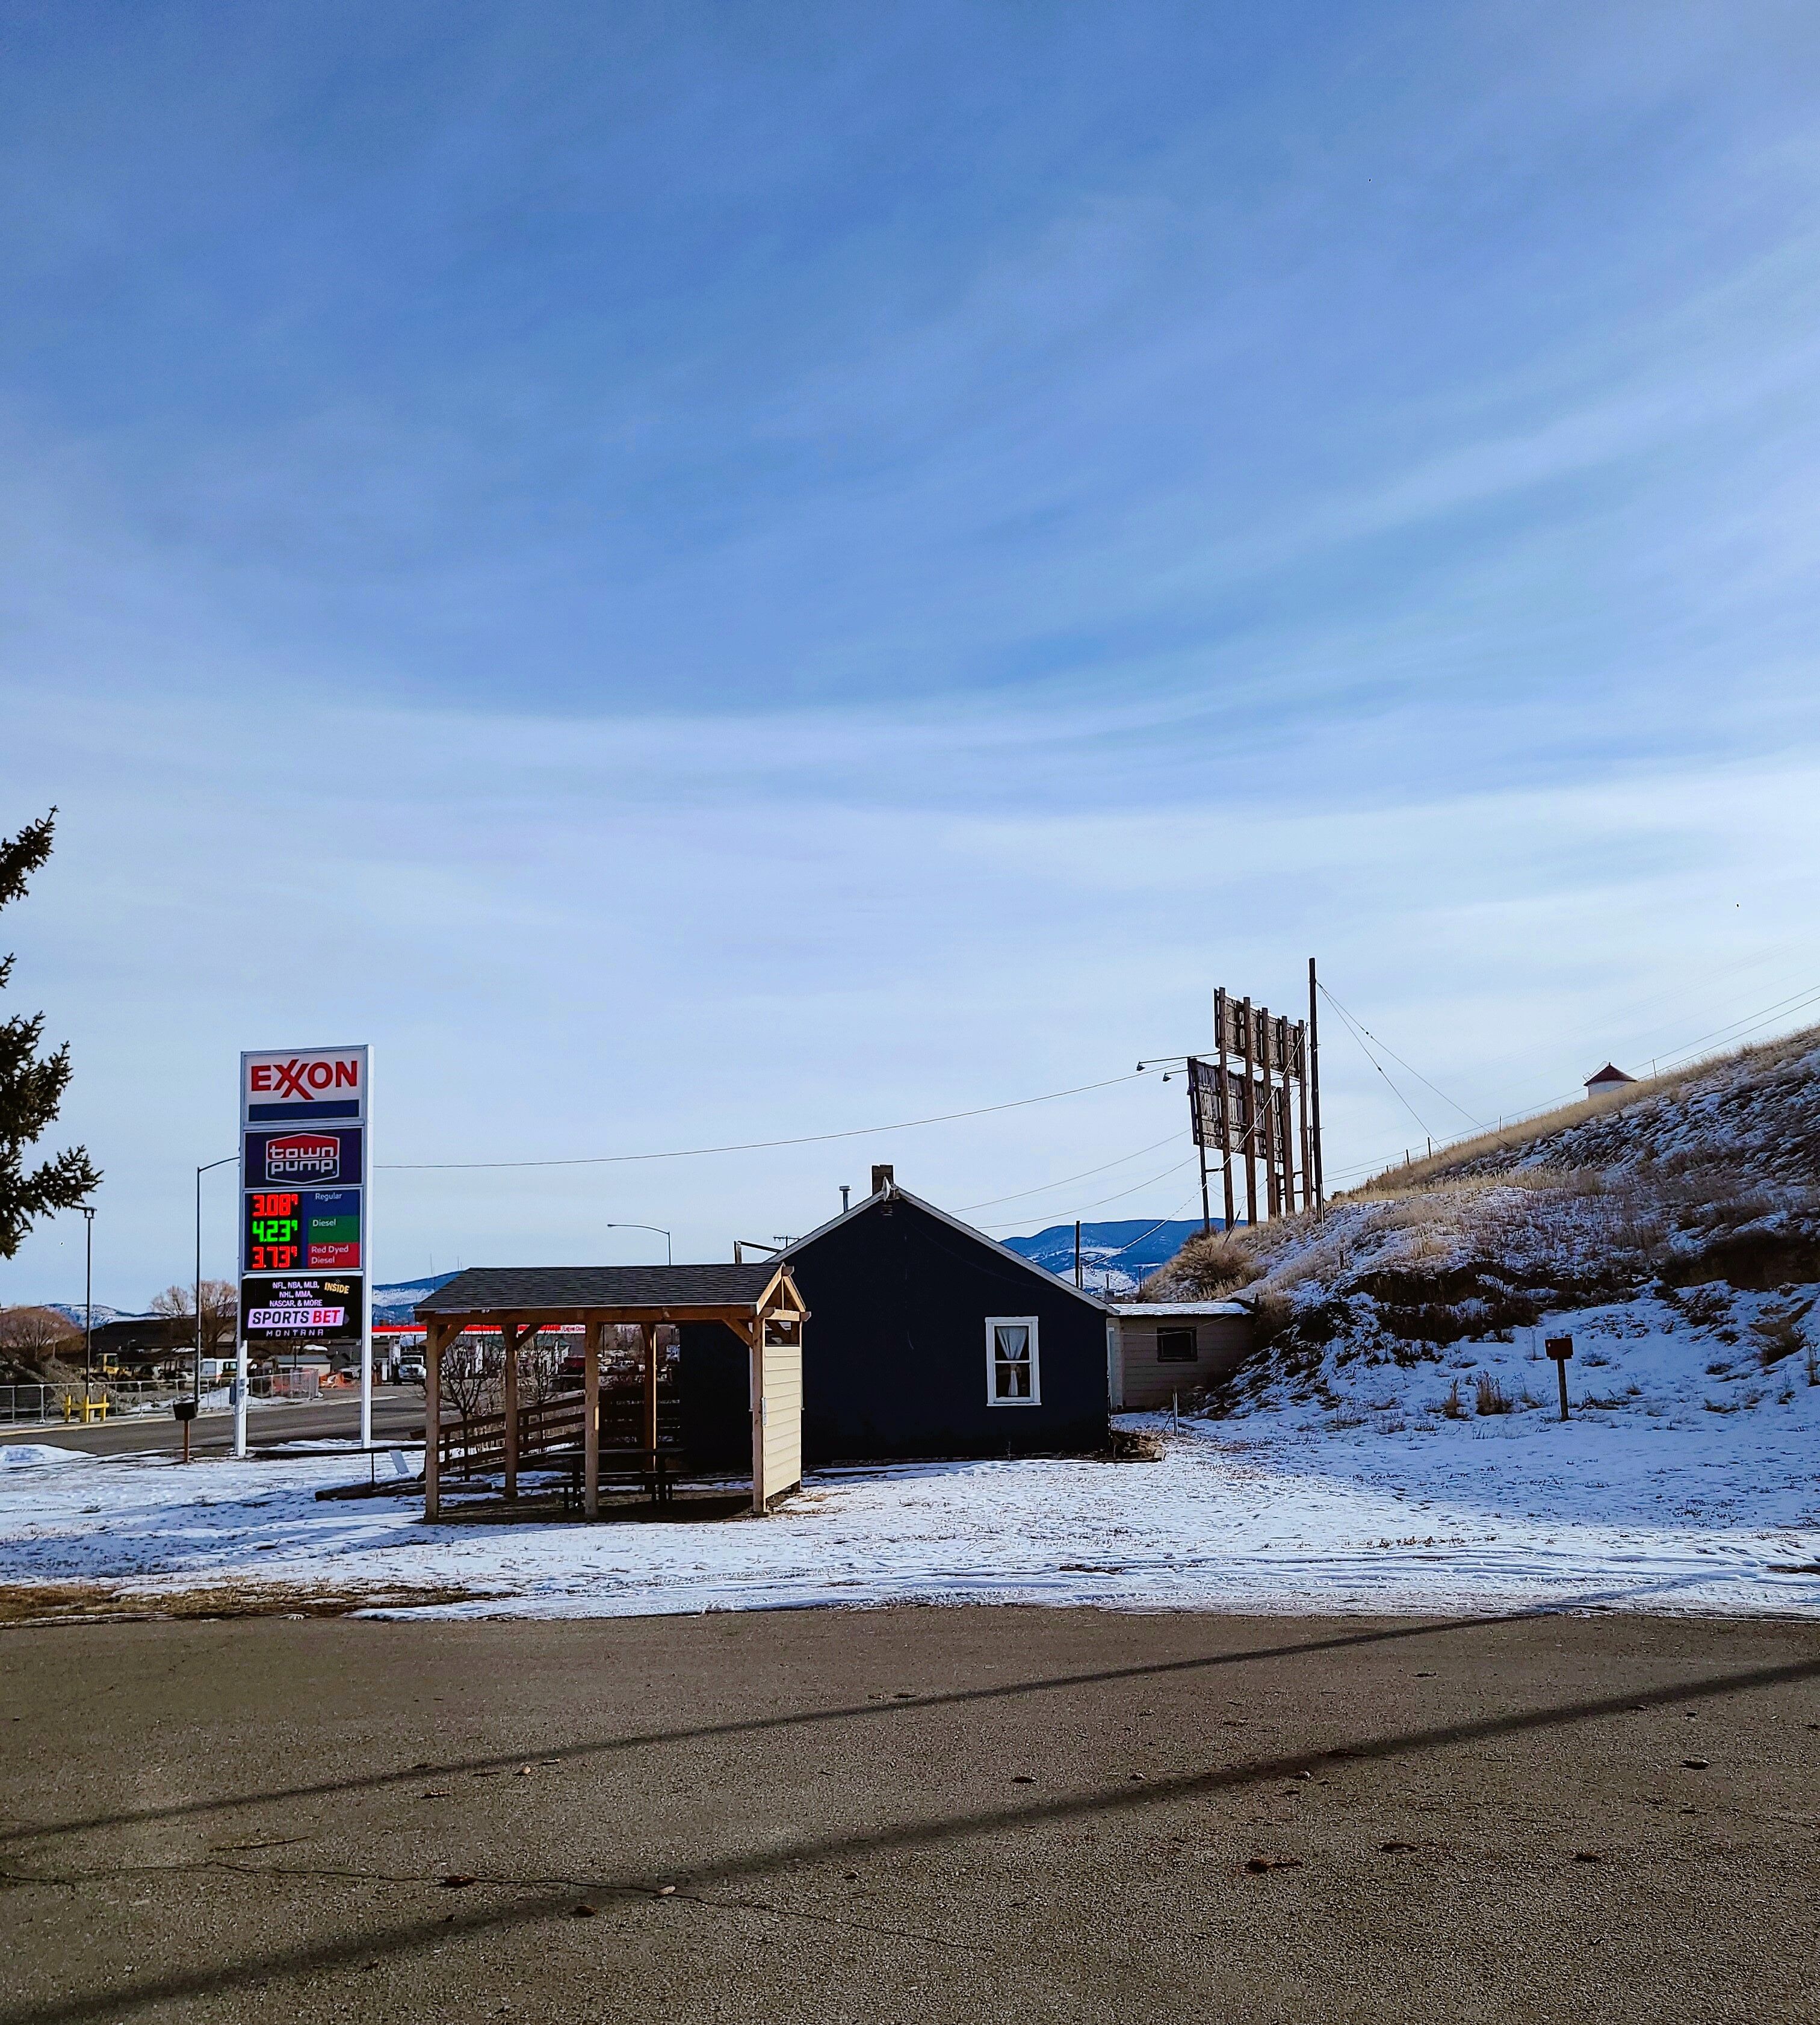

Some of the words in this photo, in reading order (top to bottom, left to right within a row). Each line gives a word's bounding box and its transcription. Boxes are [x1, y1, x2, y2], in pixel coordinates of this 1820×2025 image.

[251, 1059, 358, 1100] EXXON
[270, 1146, 334, 1159] town
[271, 1159, 333, 1175] pump
[315, 1192, 342, 1202] Regular
[329, 1245, 348, 1255] Dyed
[324, 1282, 350, 1294] INSIDE
[252, 1311, 309, 1324] SPORTS
[313, 1310, 340, 1323] BET
